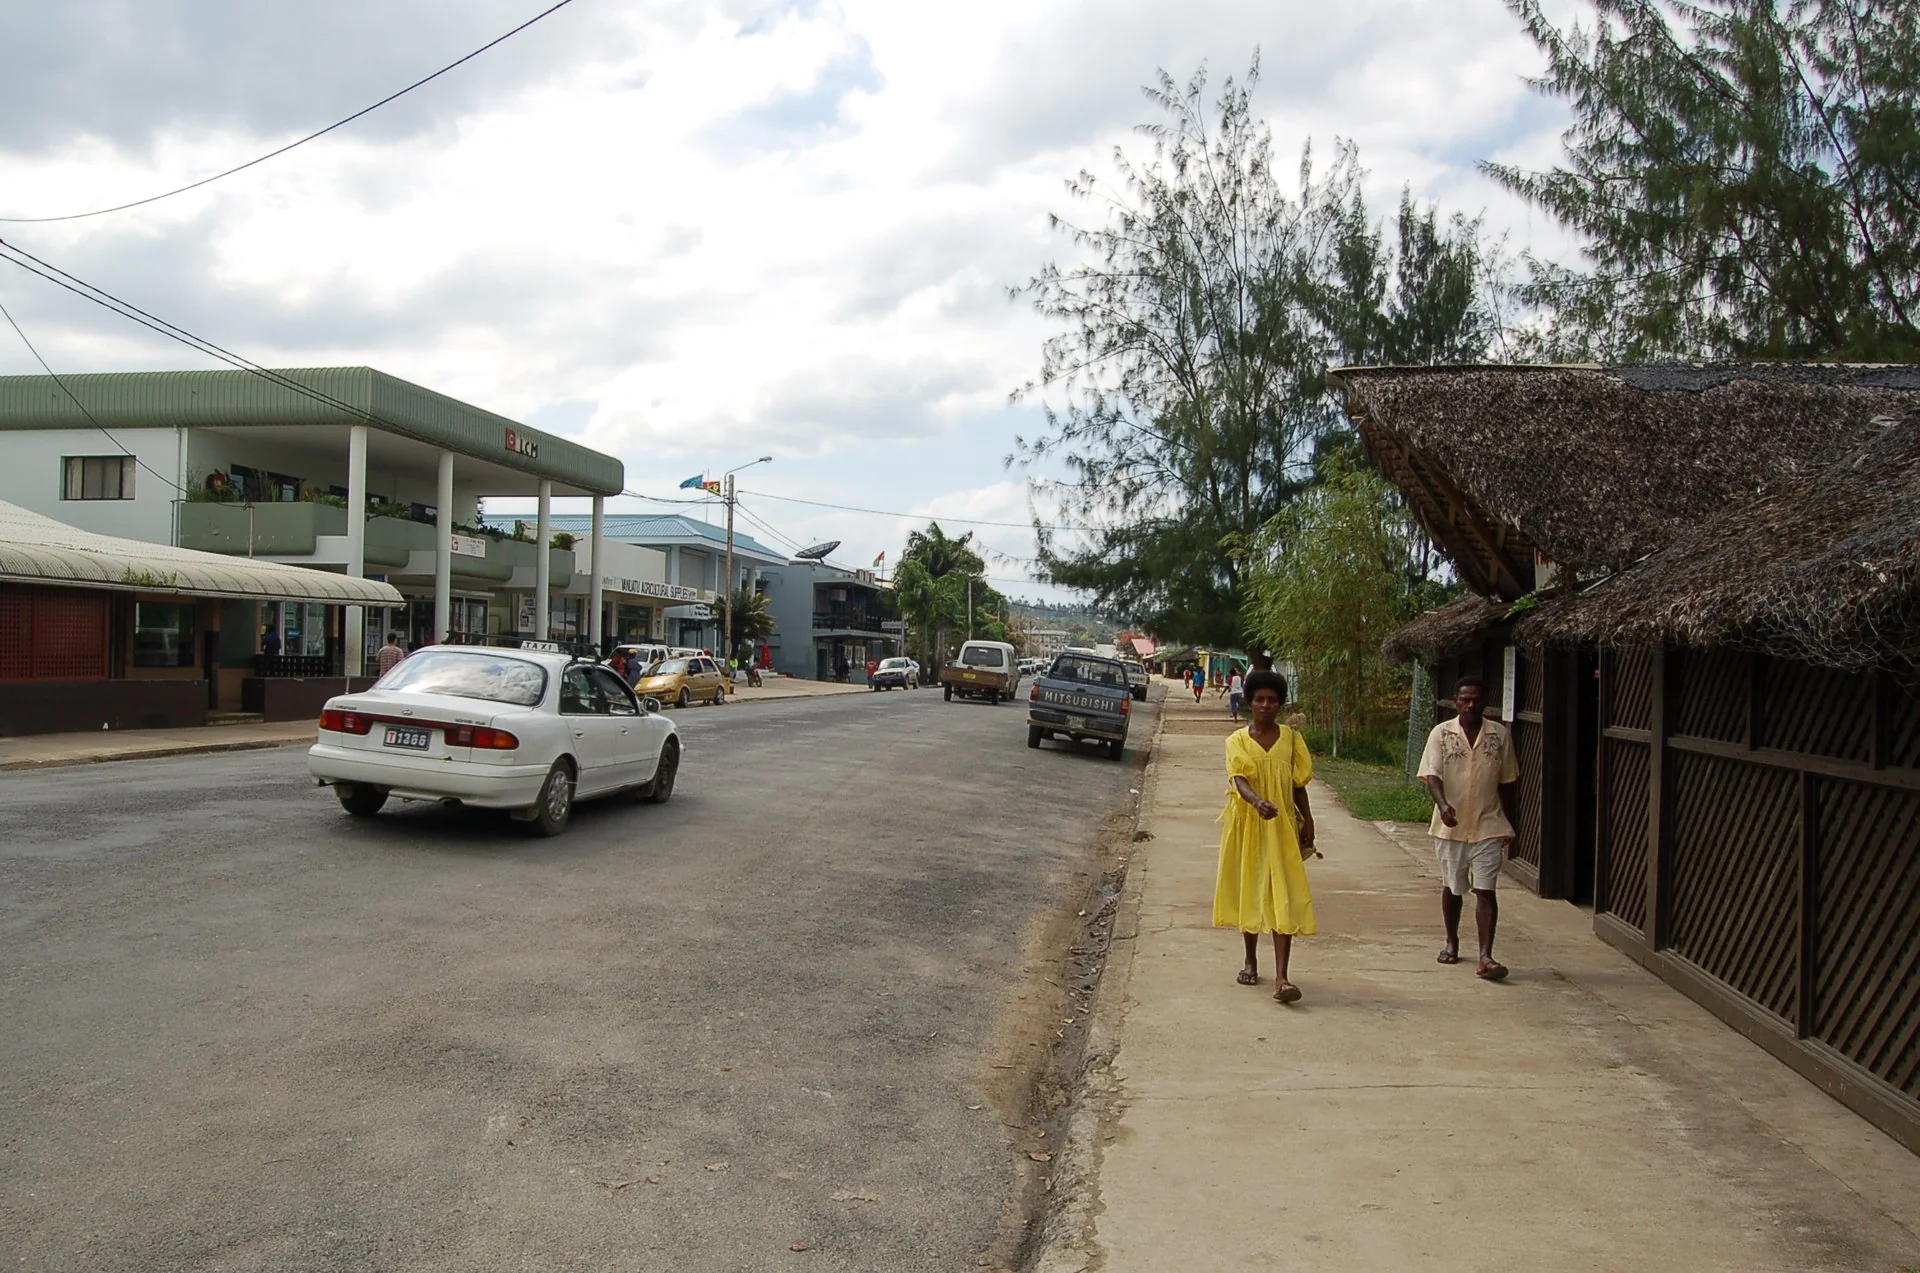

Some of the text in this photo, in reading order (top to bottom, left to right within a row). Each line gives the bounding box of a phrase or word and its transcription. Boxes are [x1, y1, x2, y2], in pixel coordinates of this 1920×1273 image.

[520, 439, 538, 459] LCM
[621, 578, 640, 593] VANUATU
[641, 581, 669, 598] AGRICULTURAL
[670, 586, 688, 600] SUPPLIES
[525, 641, 552, 650] TAXI
[1045, 691, 1114, 711] MITSUBISHI
